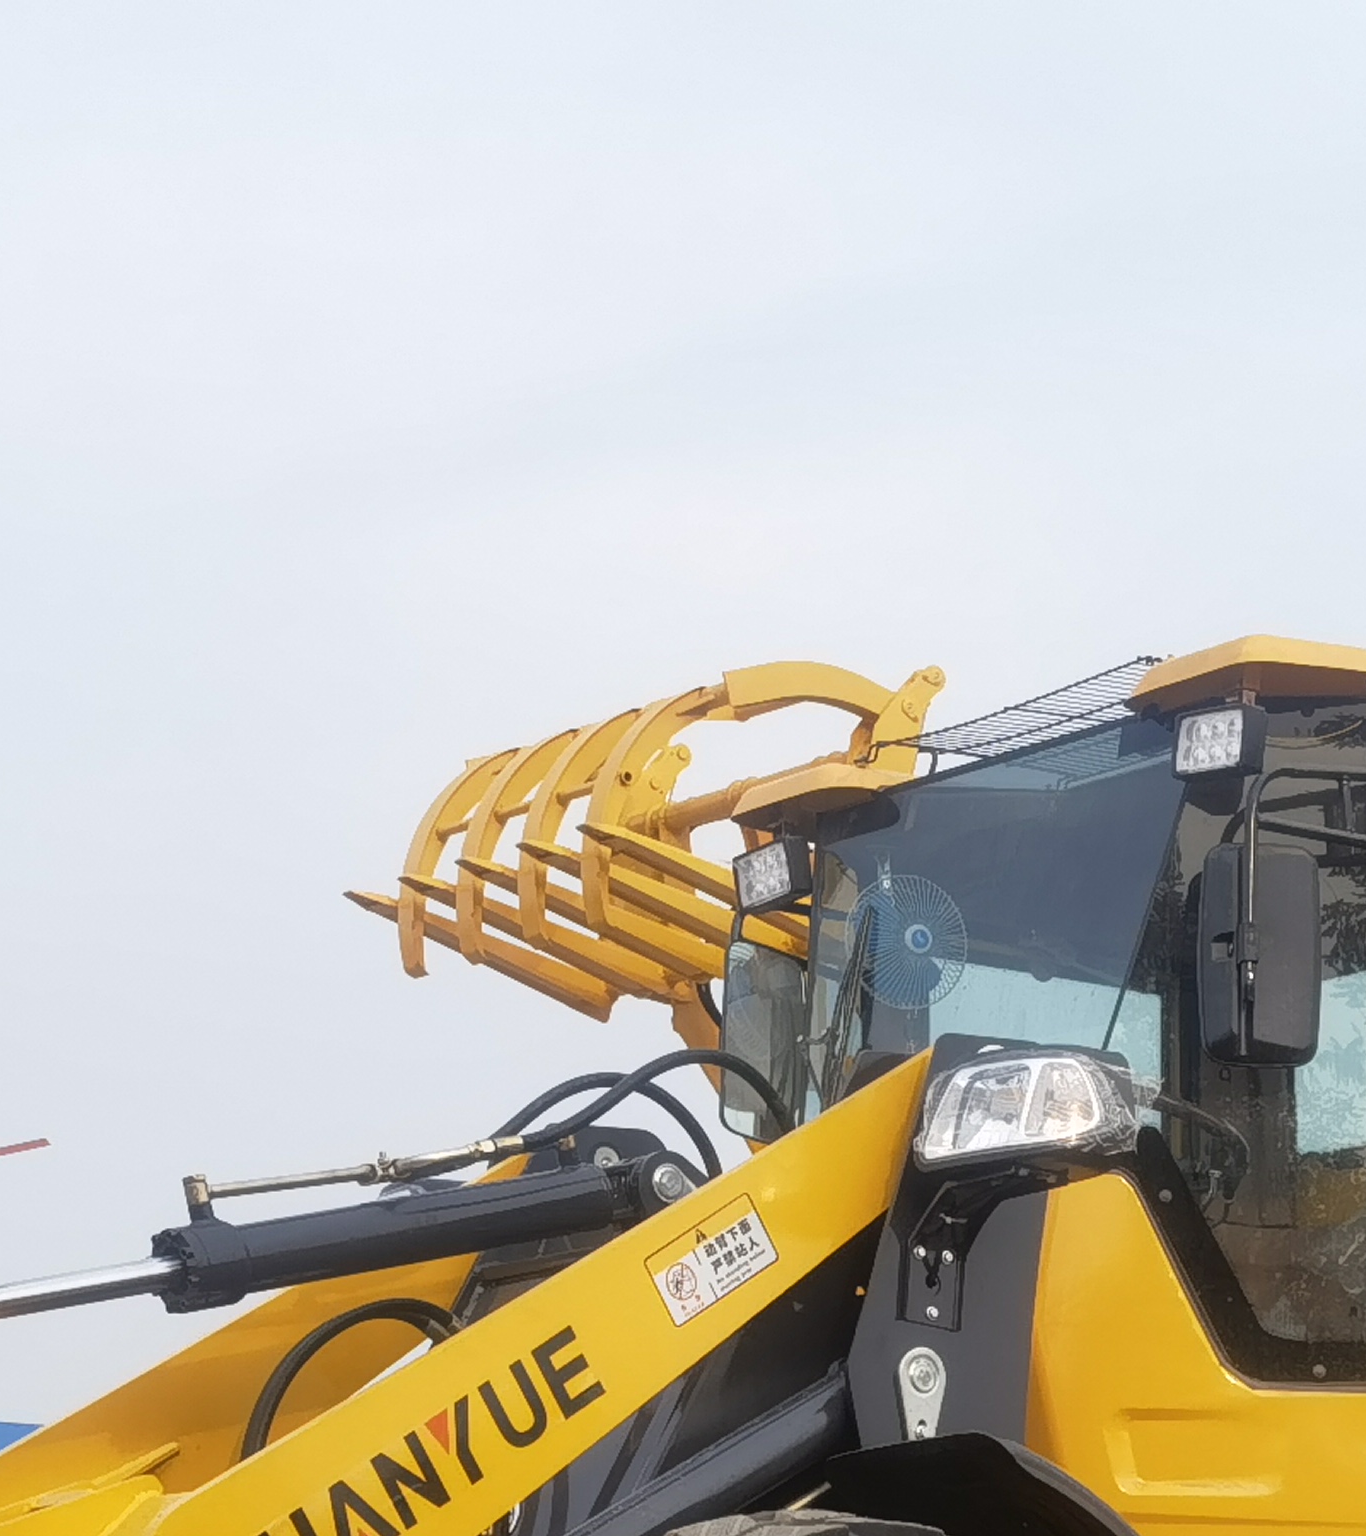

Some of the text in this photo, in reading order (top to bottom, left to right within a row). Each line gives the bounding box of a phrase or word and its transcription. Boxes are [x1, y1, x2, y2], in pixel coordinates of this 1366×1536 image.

[703, 1217, 752, 1258] 动臂下面
[710, 1236, 760, 1275] 严禁站人
